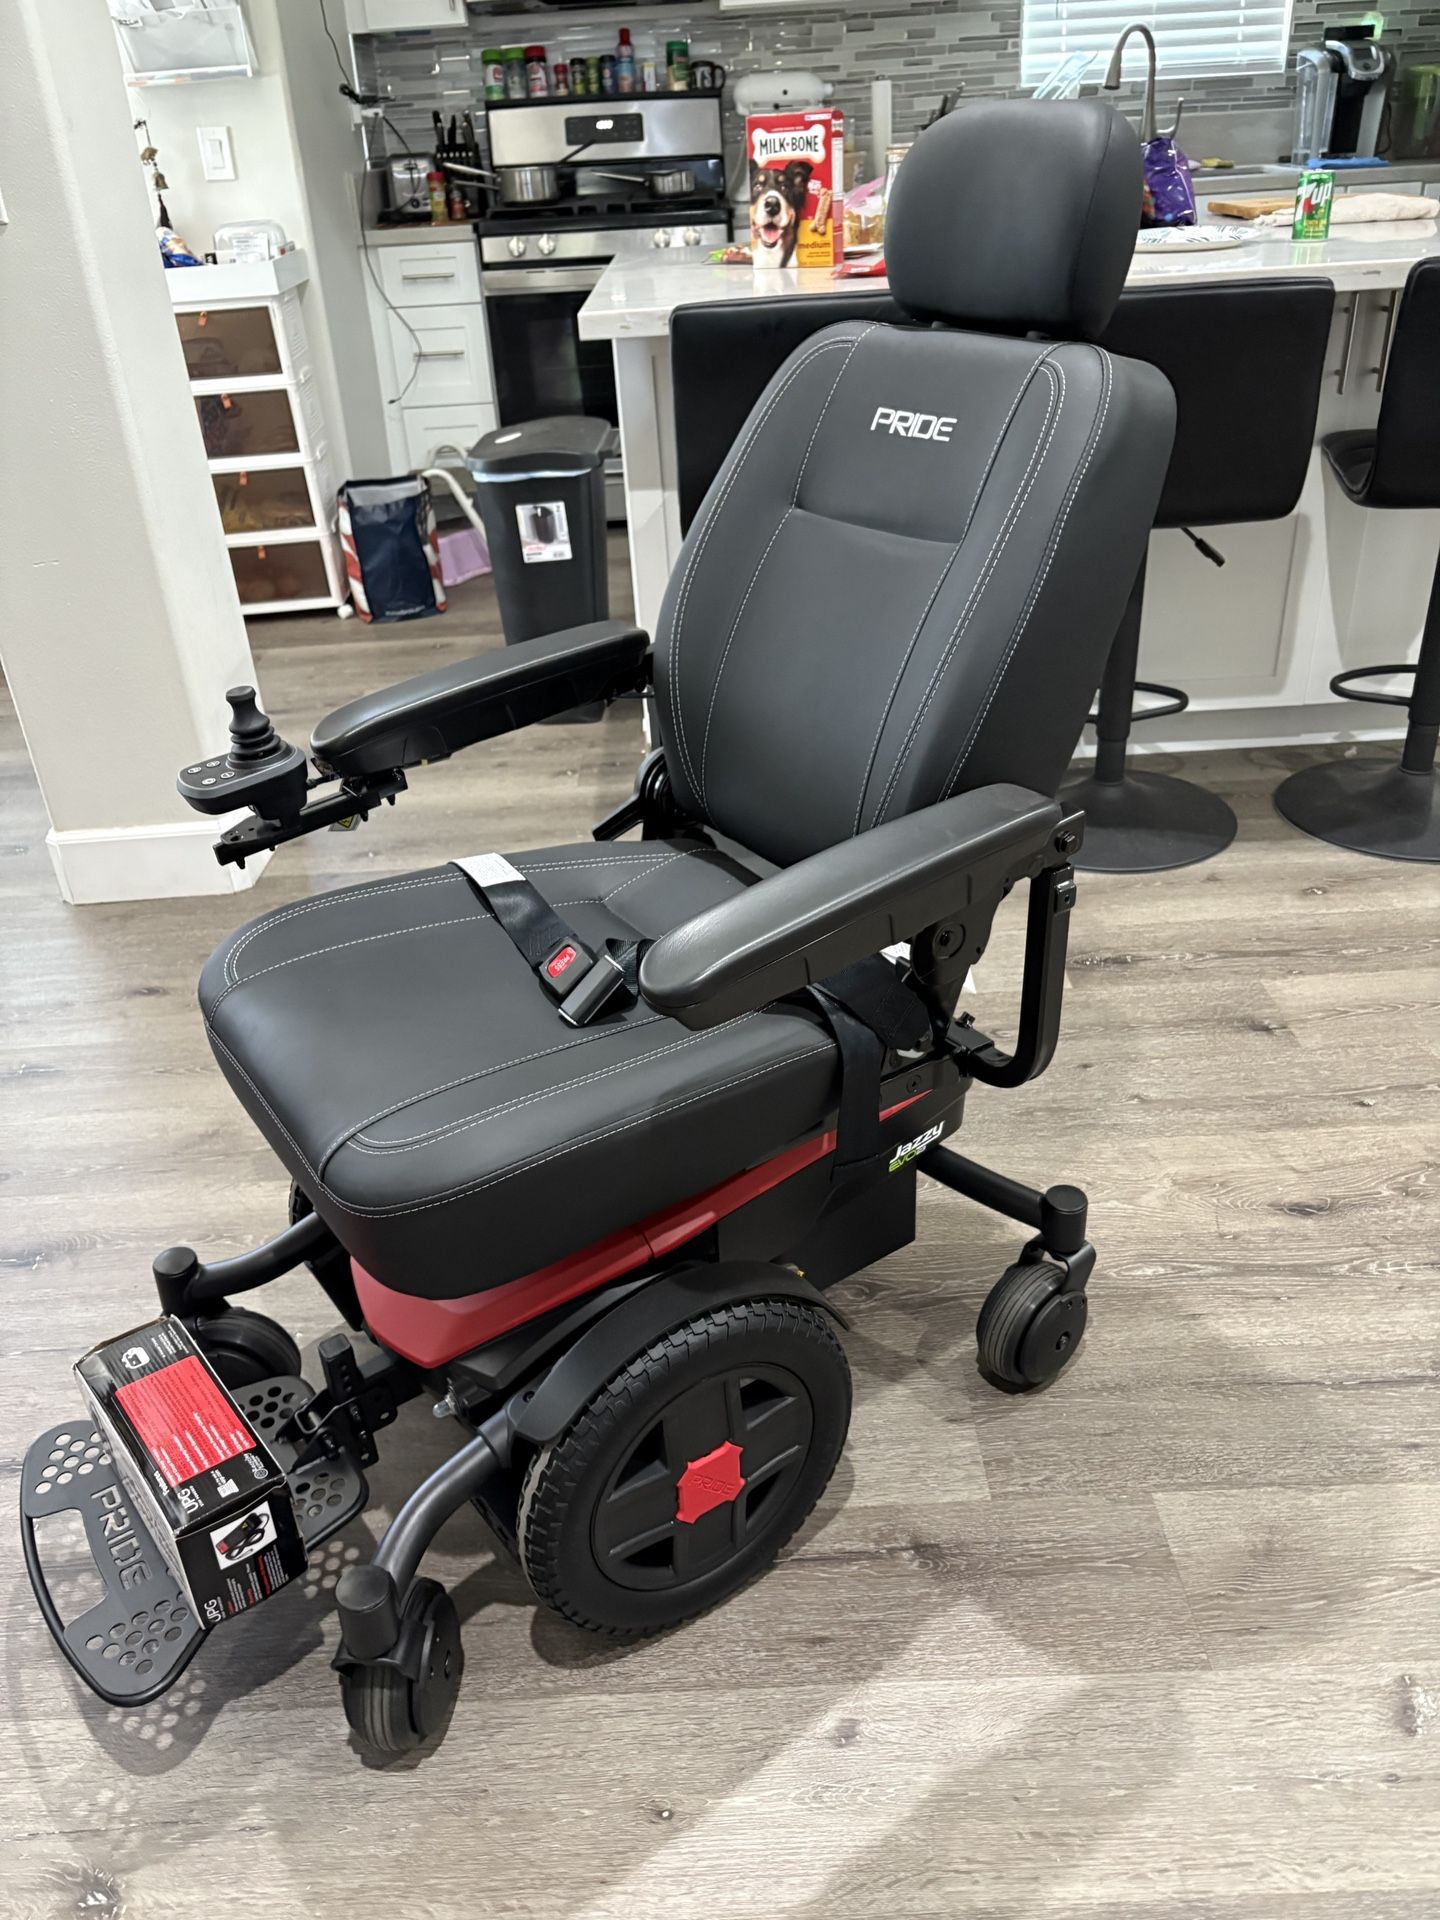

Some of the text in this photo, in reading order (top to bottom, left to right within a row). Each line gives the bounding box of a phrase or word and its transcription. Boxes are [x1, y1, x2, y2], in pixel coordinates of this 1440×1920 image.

[870, 406, 958, 442] PRIDE
[889, 1120, 945, 1164] Jazzy
[153, 1470, 170, 1496] Features
[691, 1474, 735, 1495] PRIDE
[177, 1487, 200, 1514] UPG
[90, 1483, 153, 1591] PRIDE
